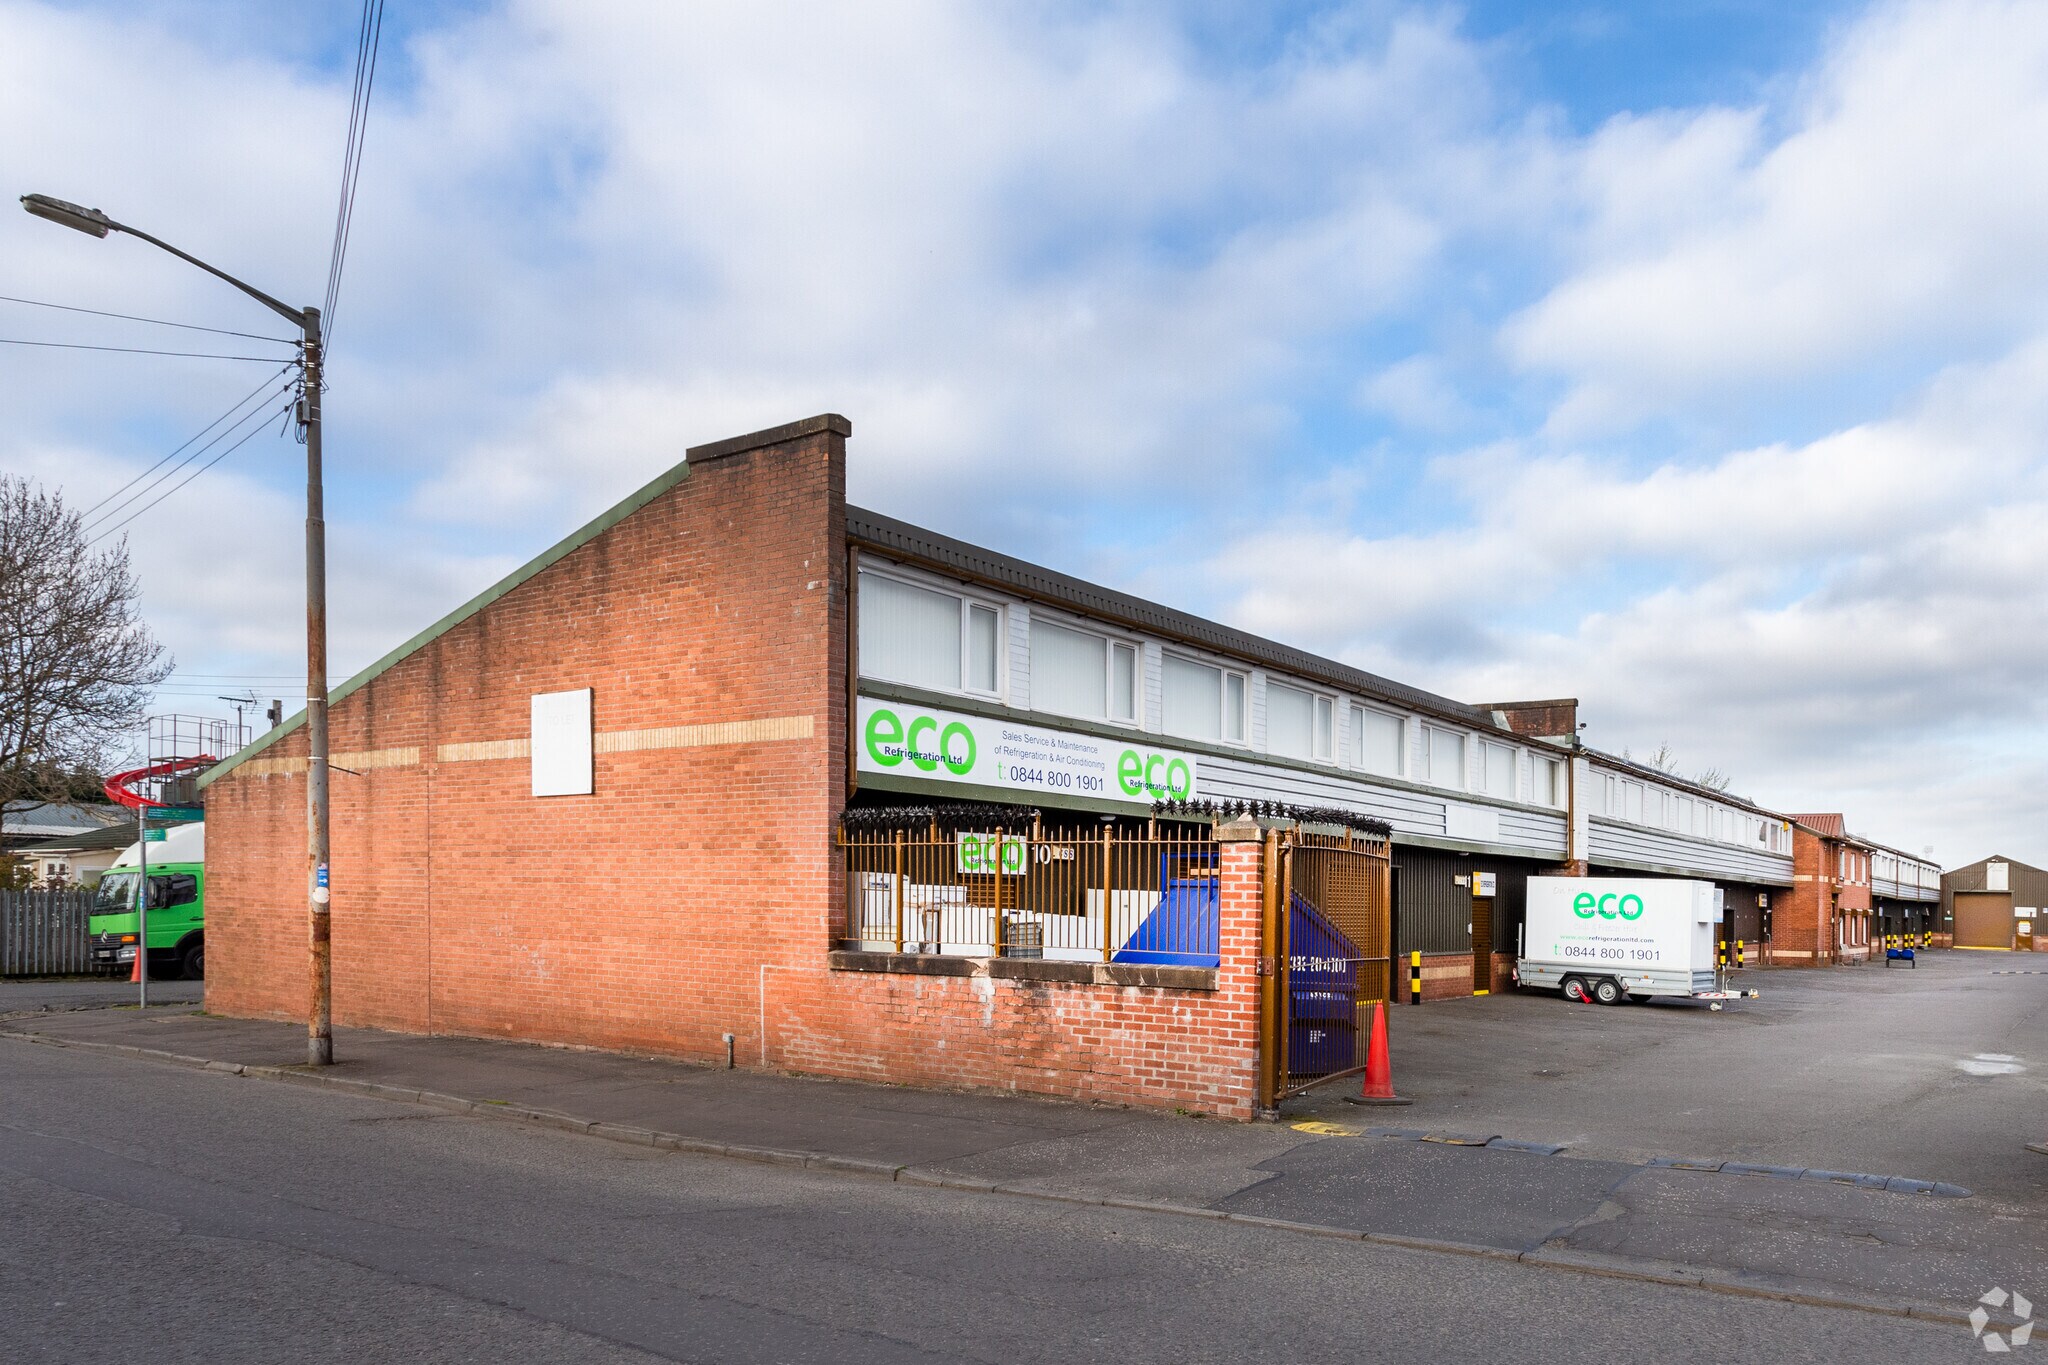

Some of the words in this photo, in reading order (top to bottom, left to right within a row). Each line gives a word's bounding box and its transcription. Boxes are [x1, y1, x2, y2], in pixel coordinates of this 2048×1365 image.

[865, 709, 977, 776] eco
[1002, 730, 1022, 742] Sales
[1024, 734, 1049, 747] Service
[1050, 738, 1056, 748] &
[1058, 739, 1098, 754] Maintenance
[884, 746, 946, 763] Refrigeration
[948, 754, 963, 765] Ltd
[994, 745, 1002, 755] of
[1003, 746, 1047, 761] Refrigeration
[1049, 753, 1055, 763] &
[1055, 754, 1065, 763] Air
[1066, 756, 1105, 771] Conditioning
[997, 761, 1007, 781] t:
[1010, 766, 1044, 784] 0844
[1047, 771, 1071, 788] 800
[1076, 774, 1104, 792] 1901
[1117, 749, 1191, 801] eco
[1129, 779, 1171, 792] Refrigeration
[1171, 785, 1182, 793] Ltd
[1031, 843, 1052, 865] 10
[1573, 892, 1644, 921] eco
[1583, 908, 1622, 917] Refrigeration
[1565, 945, 1596, 958] 0844
[1600, 947, 1624, 960] 800
[1630, 949, 1660, 961] 1901
